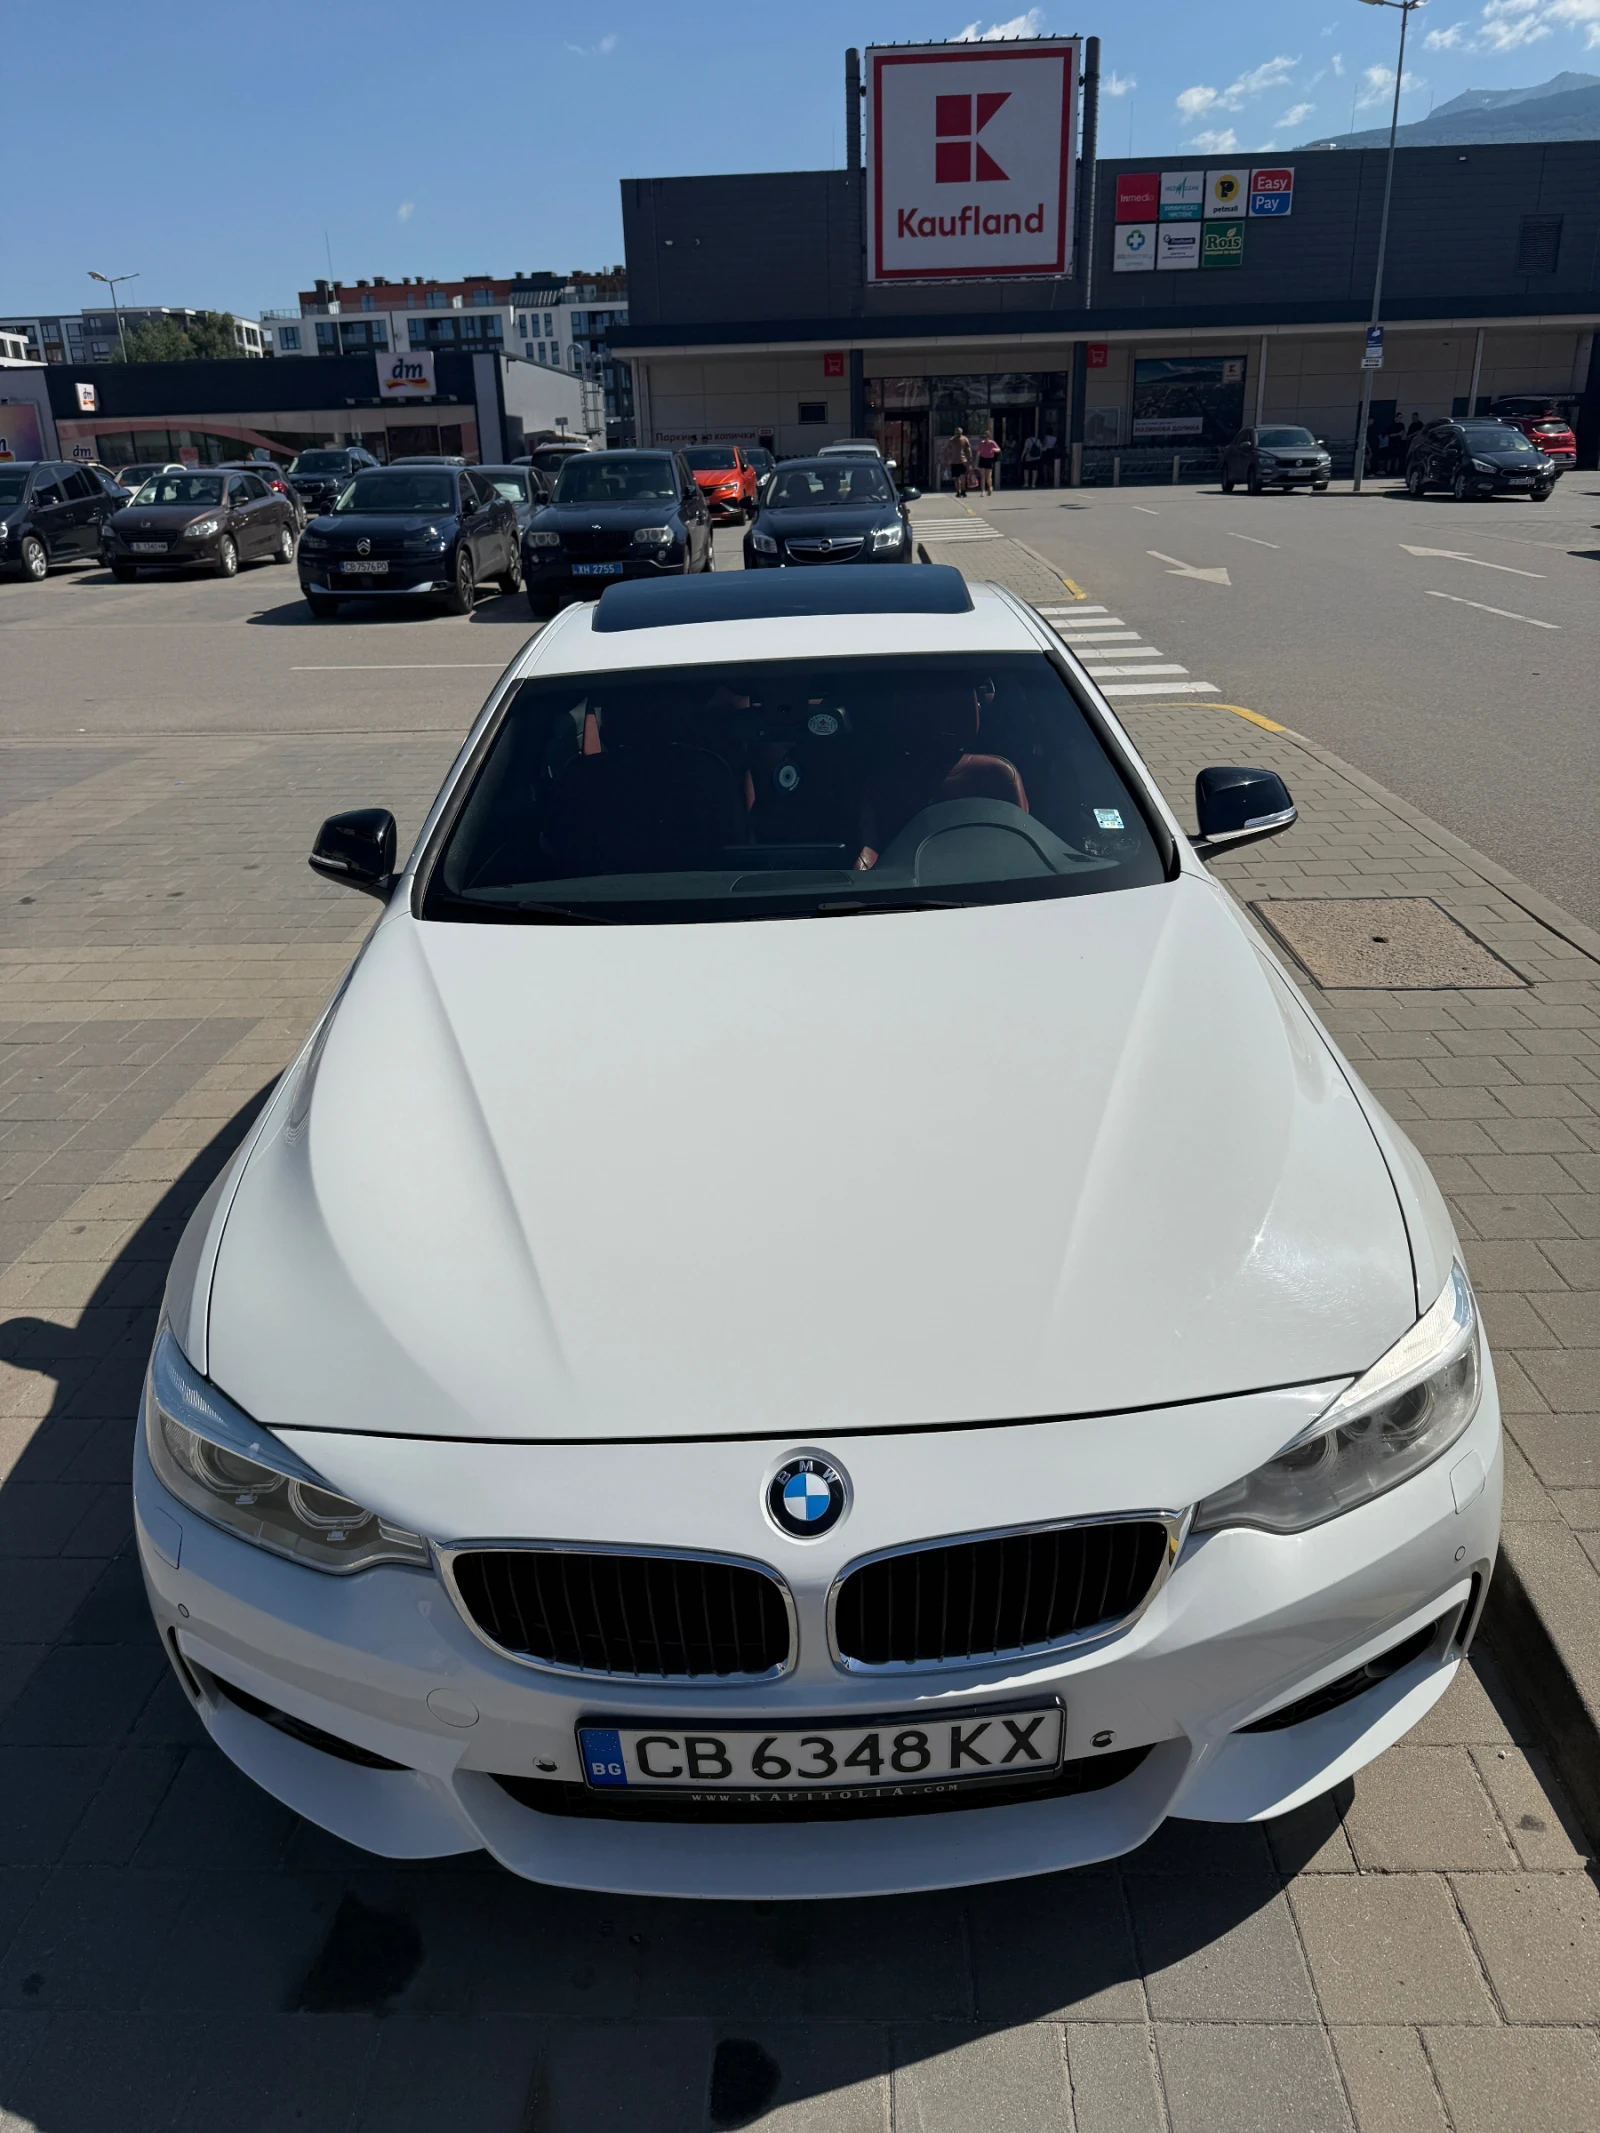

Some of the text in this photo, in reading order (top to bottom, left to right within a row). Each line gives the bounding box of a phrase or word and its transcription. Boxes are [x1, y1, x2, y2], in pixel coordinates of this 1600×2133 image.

[1257, 176, 1288, 191] Easy
[1213, 205, 1238, 214] petmall
[1255, 196, 1280, 212] Pay
[897, 203, 1044, 238] Kaufland
[1206, 235, 1241, 249] Rois
[392, 358, 423, 379] dm
[83, 388, 92, 399] dm
[714, 432, 756, 440] колички
[72, 445, 91, 457] dm
[578, 565, 590, 575] XH
[592, 564, 615, 574] 2755
[775, 1460, 839, 1486] BMW
[635, 1716, 1046, 1780] CB 6348 KX
[591, 1762, 622, 1776] BG
